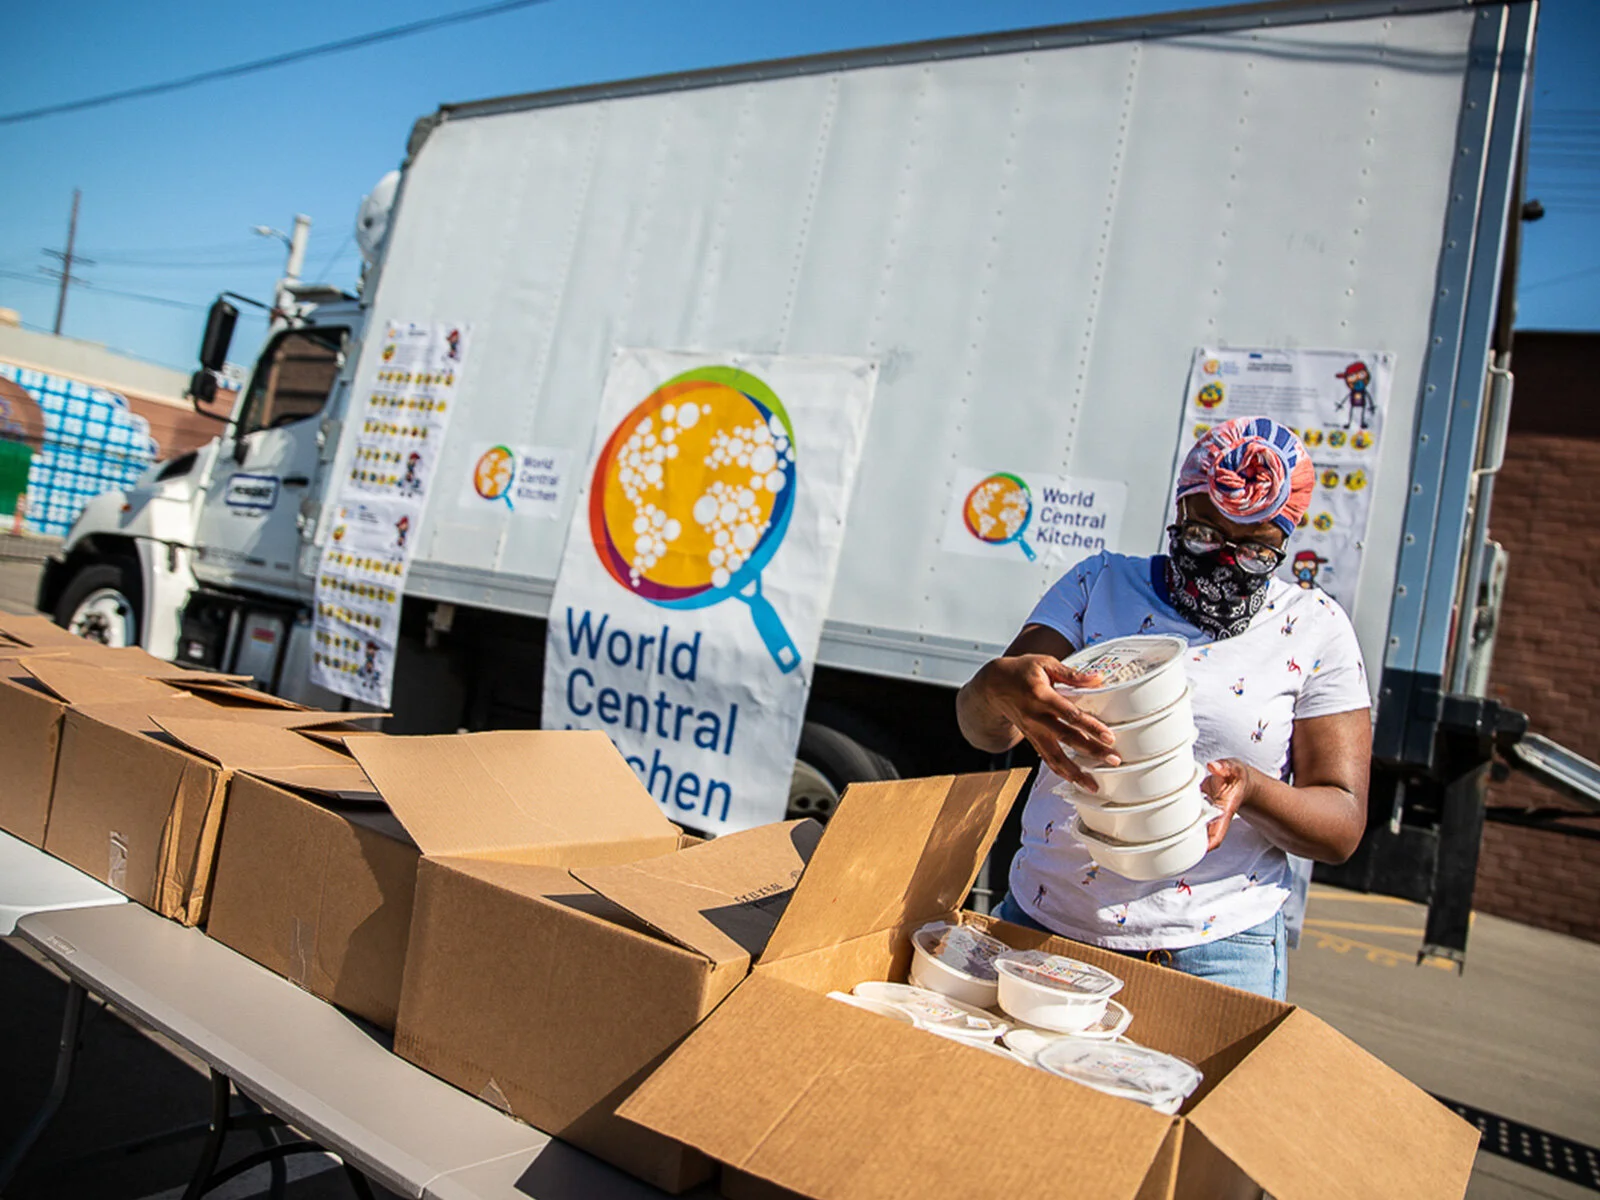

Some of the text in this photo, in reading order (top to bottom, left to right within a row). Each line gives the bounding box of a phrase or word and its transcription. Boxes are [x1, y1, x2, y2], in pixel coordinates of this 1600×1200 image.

[1042, 487, 1095, 508] World
[1039, 506, 1106, 530] Central
[1035, 526, 1105, 549] Kitchen
[566, 606, 702, 682] World
[566, 667, 738, 756] Central
